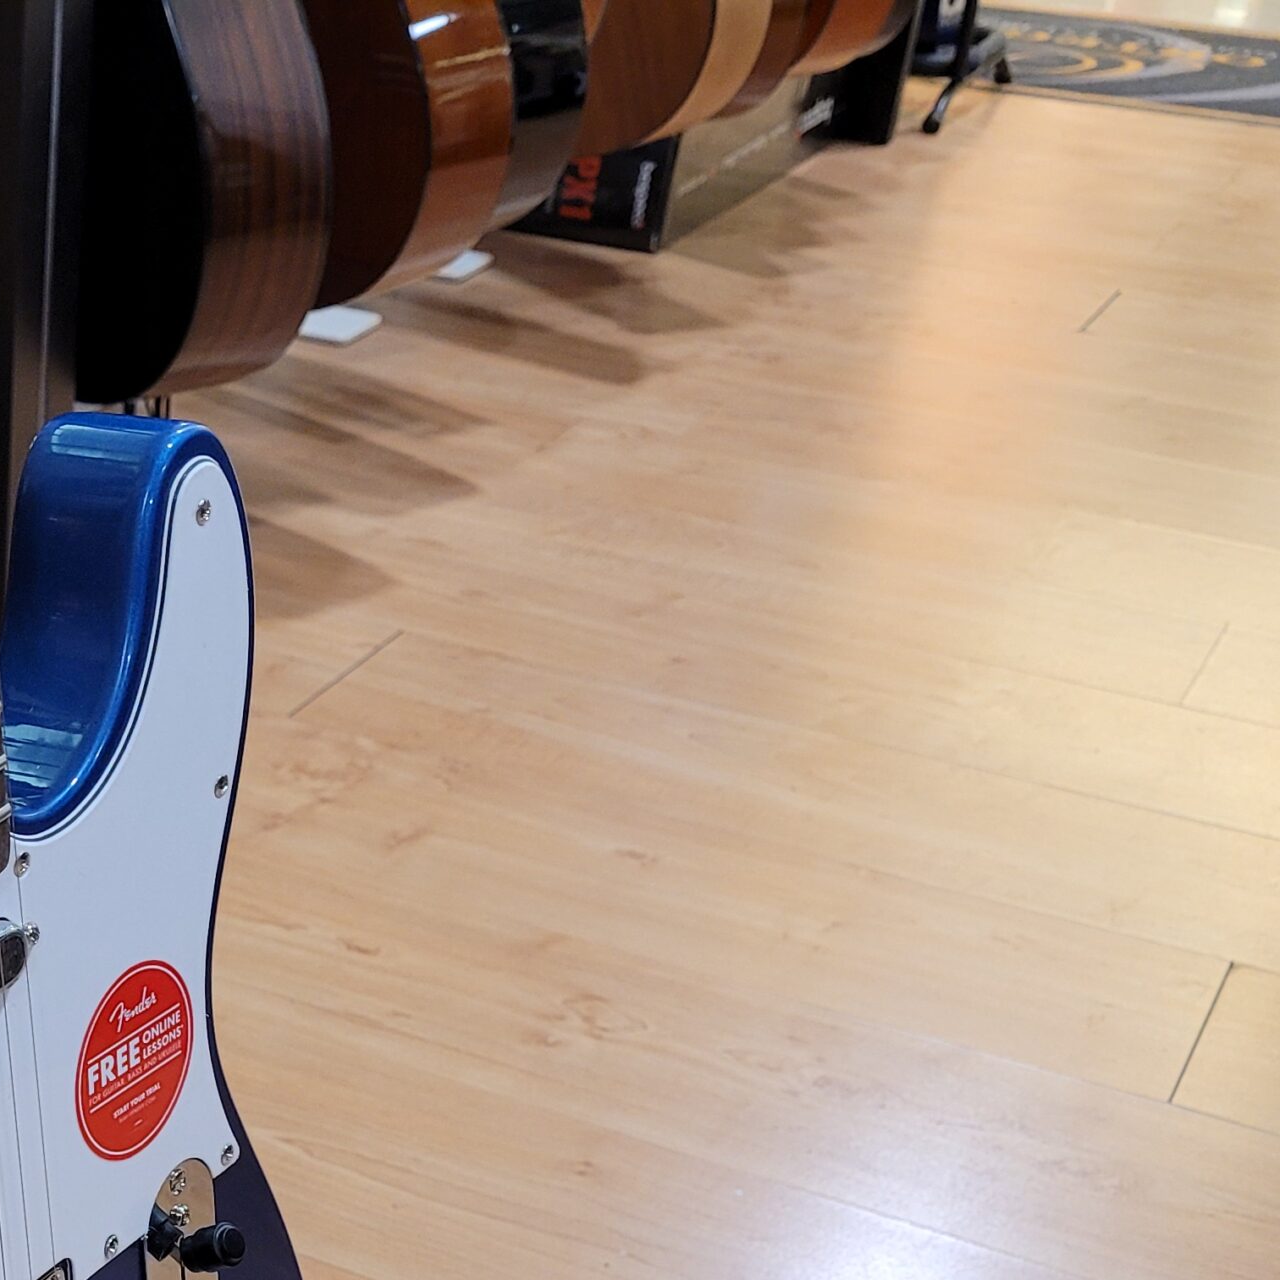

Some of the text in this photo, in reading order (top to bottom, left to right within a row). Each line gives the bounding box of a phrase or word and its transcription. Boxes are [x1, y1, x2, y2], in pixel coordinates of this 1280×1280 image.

[109, 986, 157, 1032] Fender
[87, 1010, 181, 1096] FREE ONLINE
[142, 1026, 182, 1060] LESSONS
[89, 1094, 101, 1107] FOR
[143, 1057, 157, 1070] AND
[113, 1104, 130, 1119] START
[130, 1093, 145, 1107] YOUR
[146, 1082, 161, 1096] TRIAL
